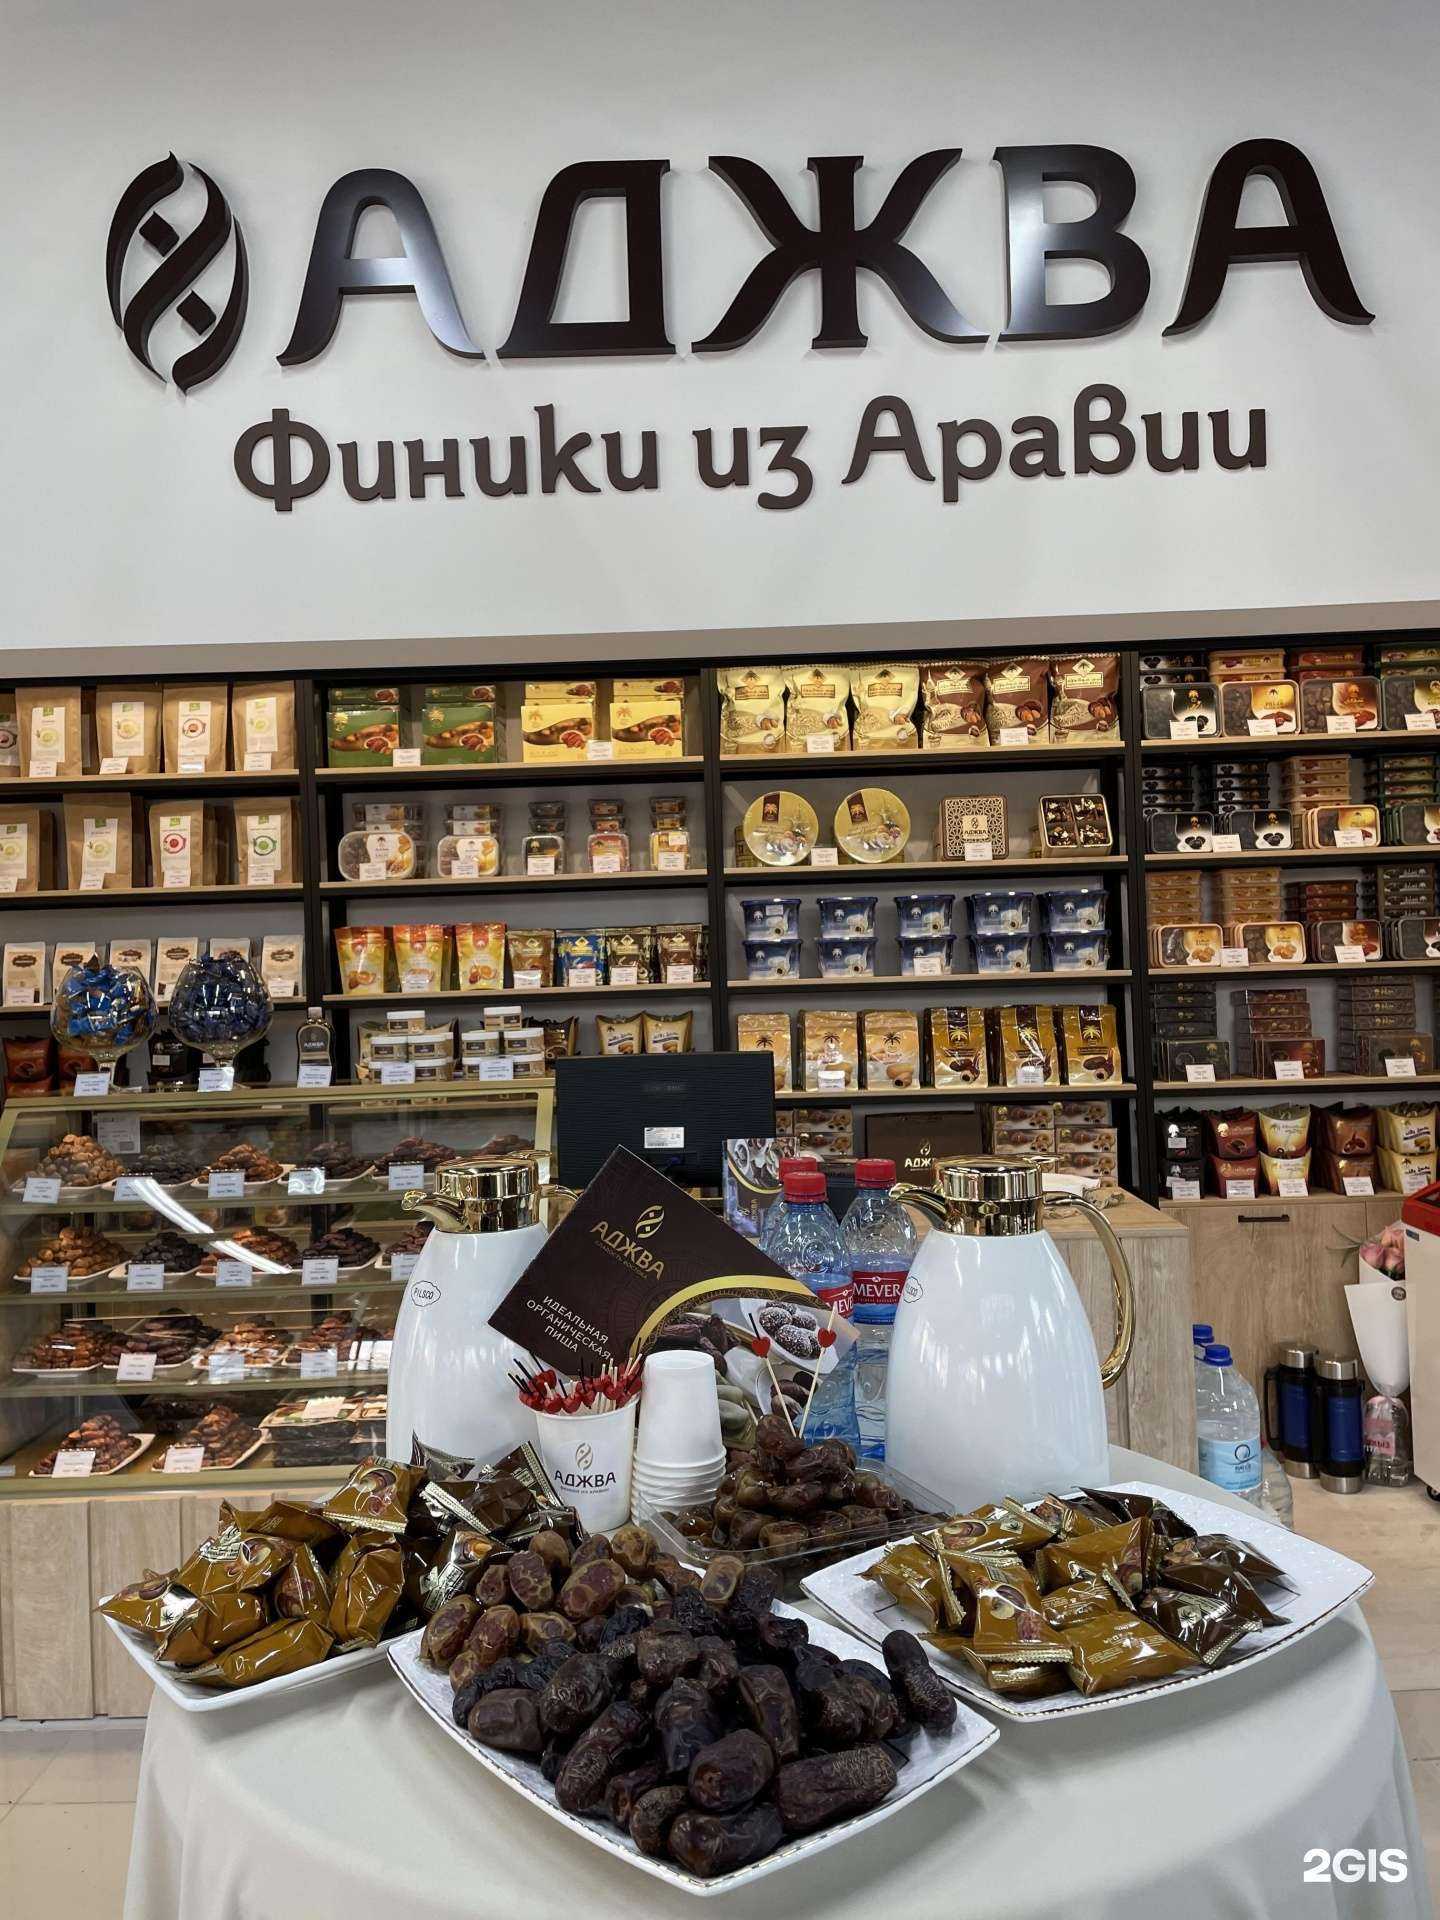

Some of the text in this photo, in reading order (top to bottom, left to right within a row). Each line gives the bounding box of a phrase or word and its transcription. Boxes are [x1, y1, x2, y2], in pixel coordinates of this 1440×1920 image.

[275, 137, 1376, 367] АДЖВА
[232, 383, 1268, 513] Финики из Аравии
[904, 1157, 931, 1168] АДЖ
[589, 1221, 665, 1281] АДЖВА
[852, 1282, 901, 1298] MEVER
[526, 1300, 611, 1360] ОРГАНИЧЕСКАЯ
[543, 1296, 609, 1344] ИДЕАЛЬНАЯ
[554, 1470, 617, 1488] АДЖВА
